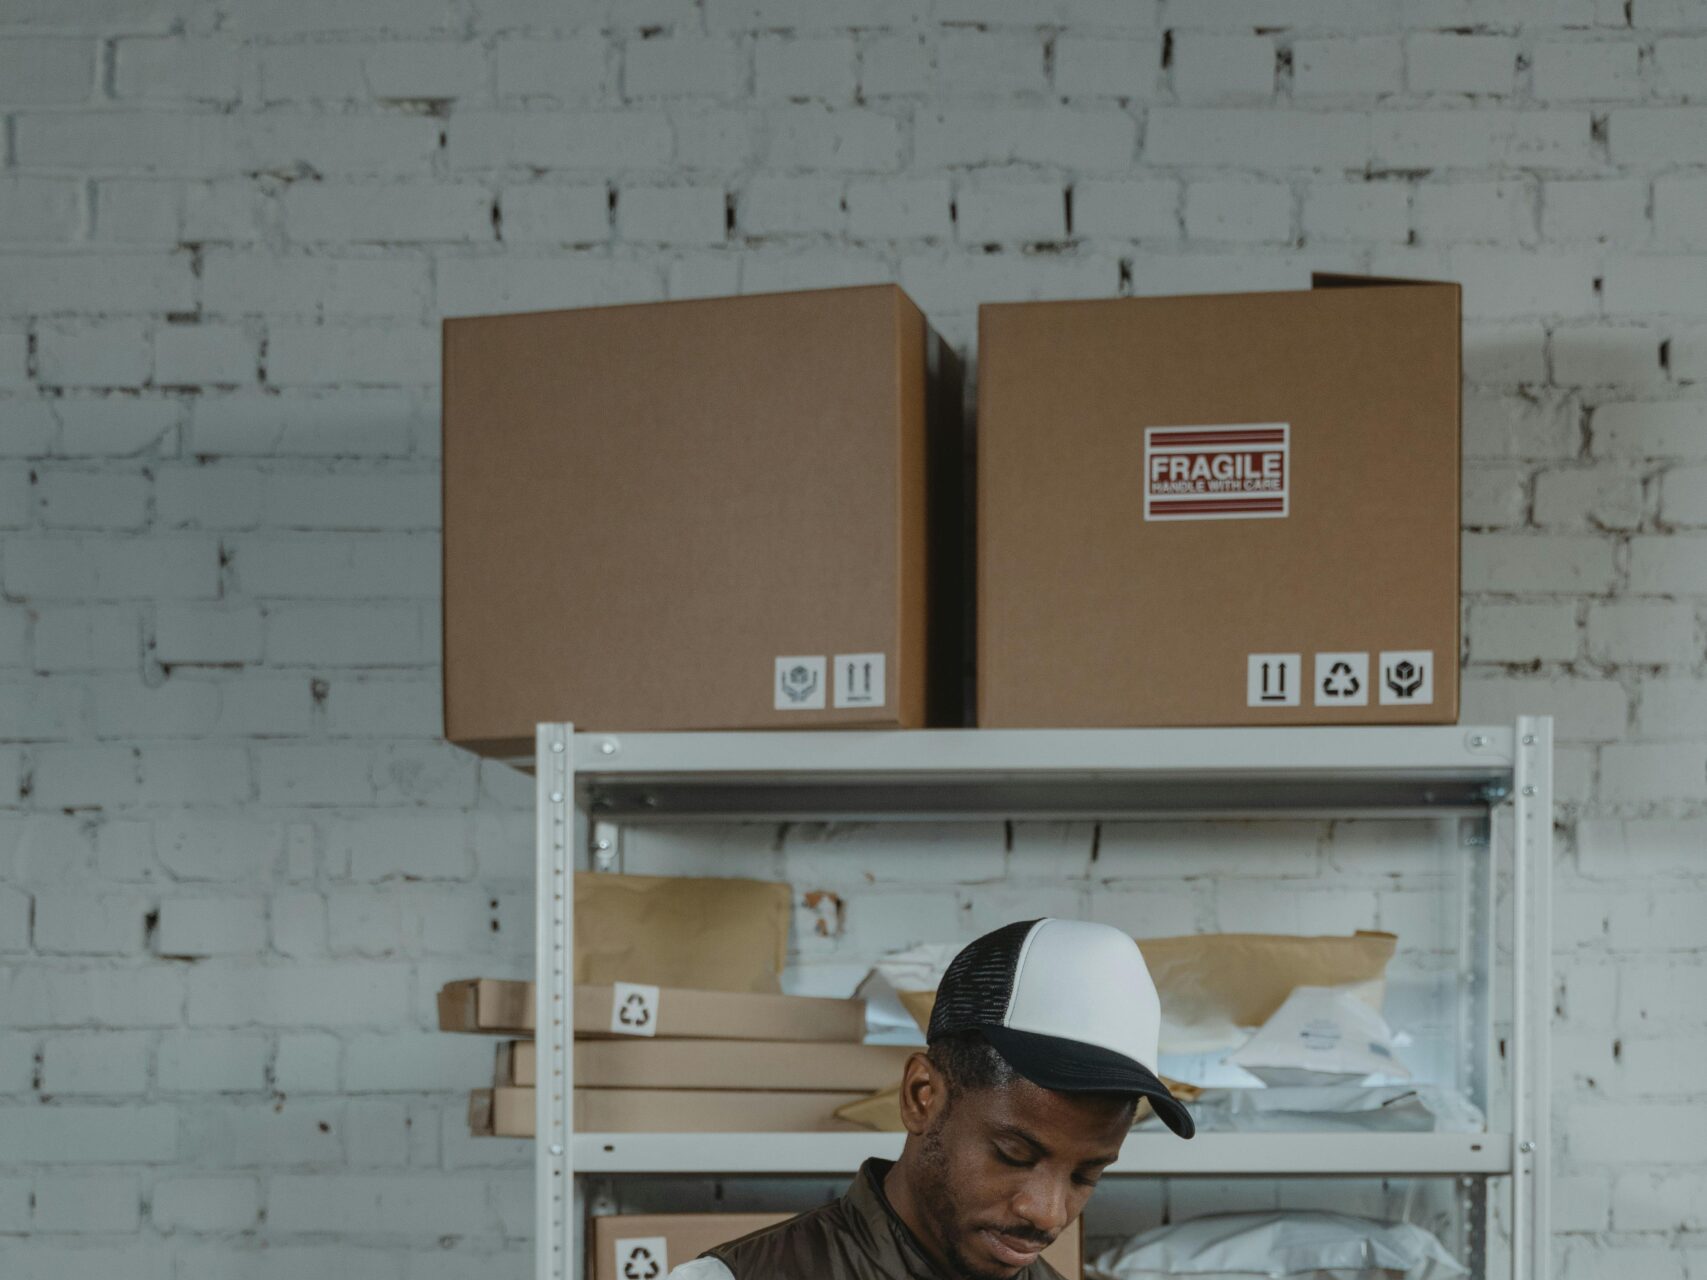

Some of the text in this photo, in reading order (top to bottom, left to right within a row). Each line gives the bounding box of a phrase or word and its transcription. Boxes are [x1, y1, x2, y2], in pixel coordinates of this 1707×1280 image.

[1151, 453, 1281, 481] FRAGILE
[1151, 478, 1281, 495] HANDLE WITH CARE
